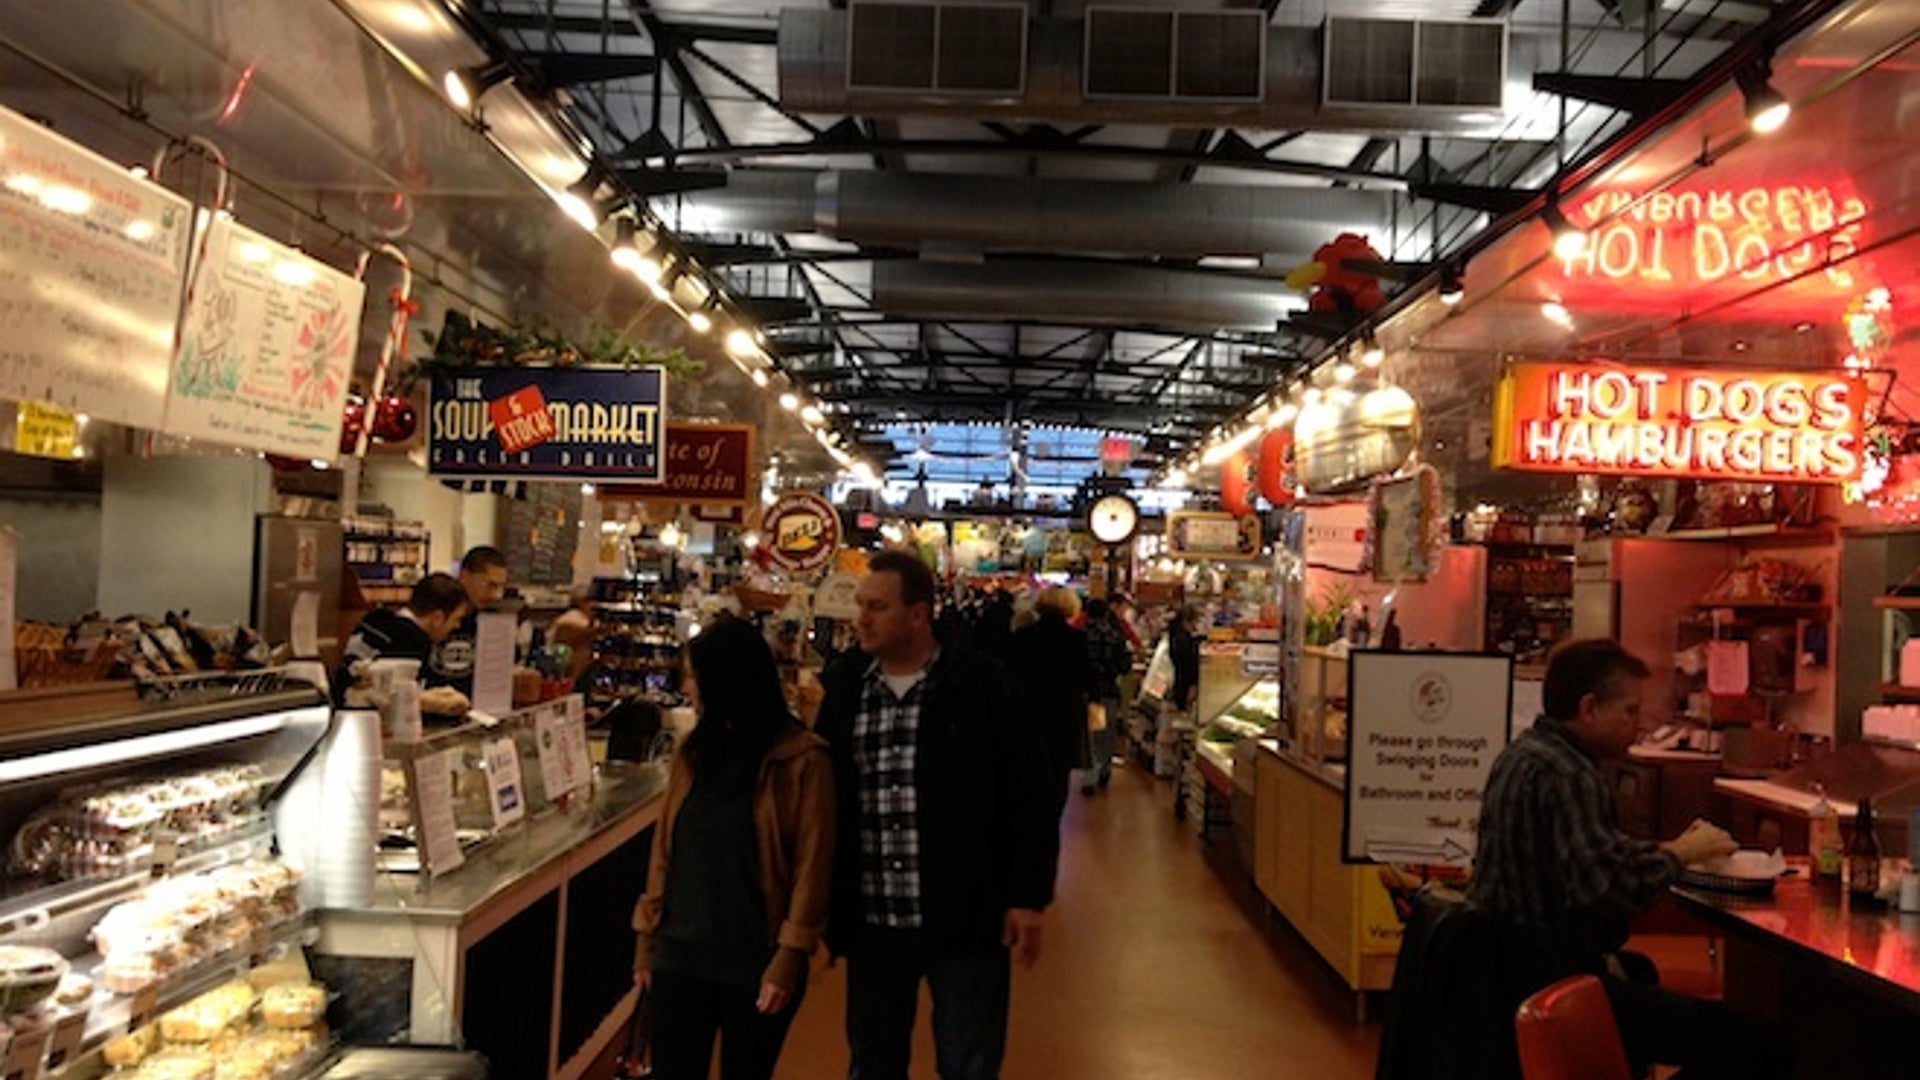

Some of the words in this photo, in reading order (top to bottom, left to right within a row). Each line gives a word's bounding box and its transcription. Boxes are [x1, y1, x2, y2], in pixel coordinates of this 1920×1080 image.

[1558, 371, 1668, 415] HOT
[1687, 378, 1850, 428] DOGS
[500, 408, 554, 449] STOCK
[547, 402, 657, 444] MARKET
[697, 437, 726, 469] of
[1528, 422, 1856, 476] HAMBURGERS
[1368, 732, 1413, 747] Please
[1417, 737, 1434, 751] go
[1437, 736, 1487, 752] through
[1376, 752, 1435, 769] Swinging
[1440, 753, 1479, 768] Doors
[1358, 785, 1423, 799] Bathroom
[1427, 788, 1451, 801] and
